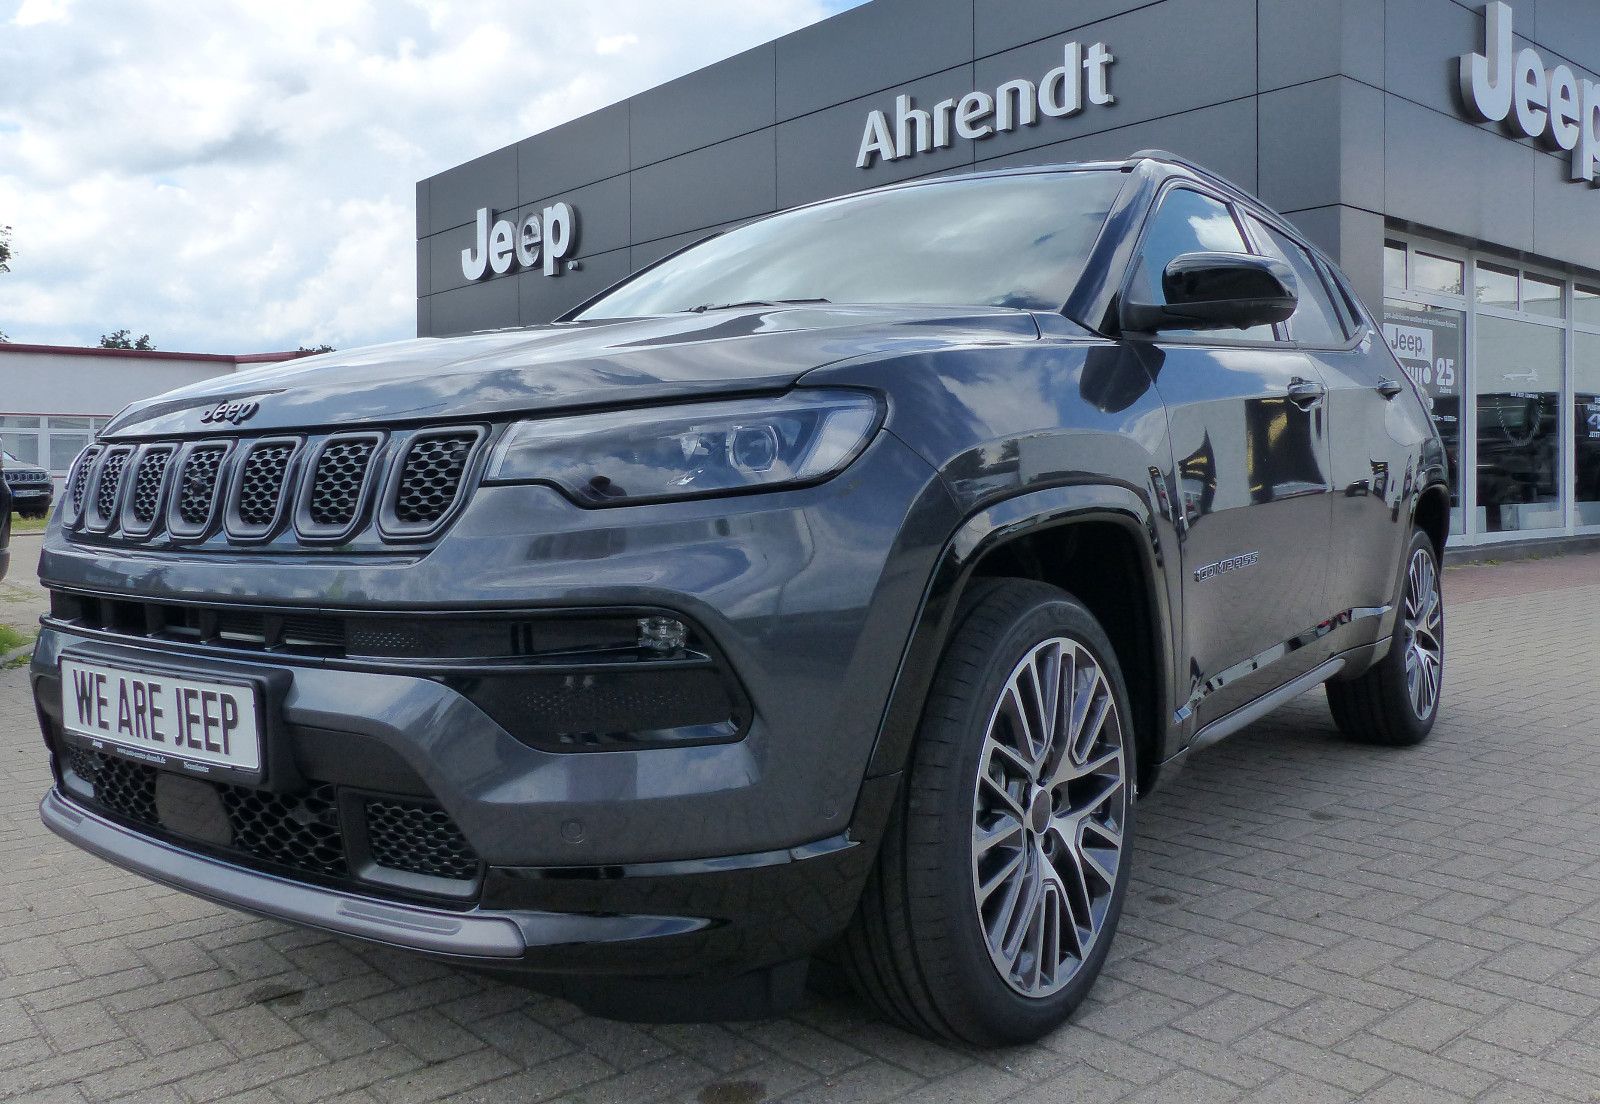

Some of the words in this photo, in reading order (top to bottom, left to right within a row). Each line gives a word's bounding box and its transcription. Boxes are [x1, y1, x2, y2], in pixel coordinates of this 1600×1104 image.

[855, 41, 1115, 169] Ahrendt
[1460, 1, 1600, 184] Jeep
[461, 202, 577, 281] Jeep
[1391, 327, 1423, 359] Jeep
[1436, 357, 1455, 387] 25
[200, 400, 260, 425] Jeep
[1194, 551, 1259, 582] COMPASS
[73, 669, 110, 731] WE
[118, 677, 165, 743] ARE
[174, 687, 239, 756] JEEP
